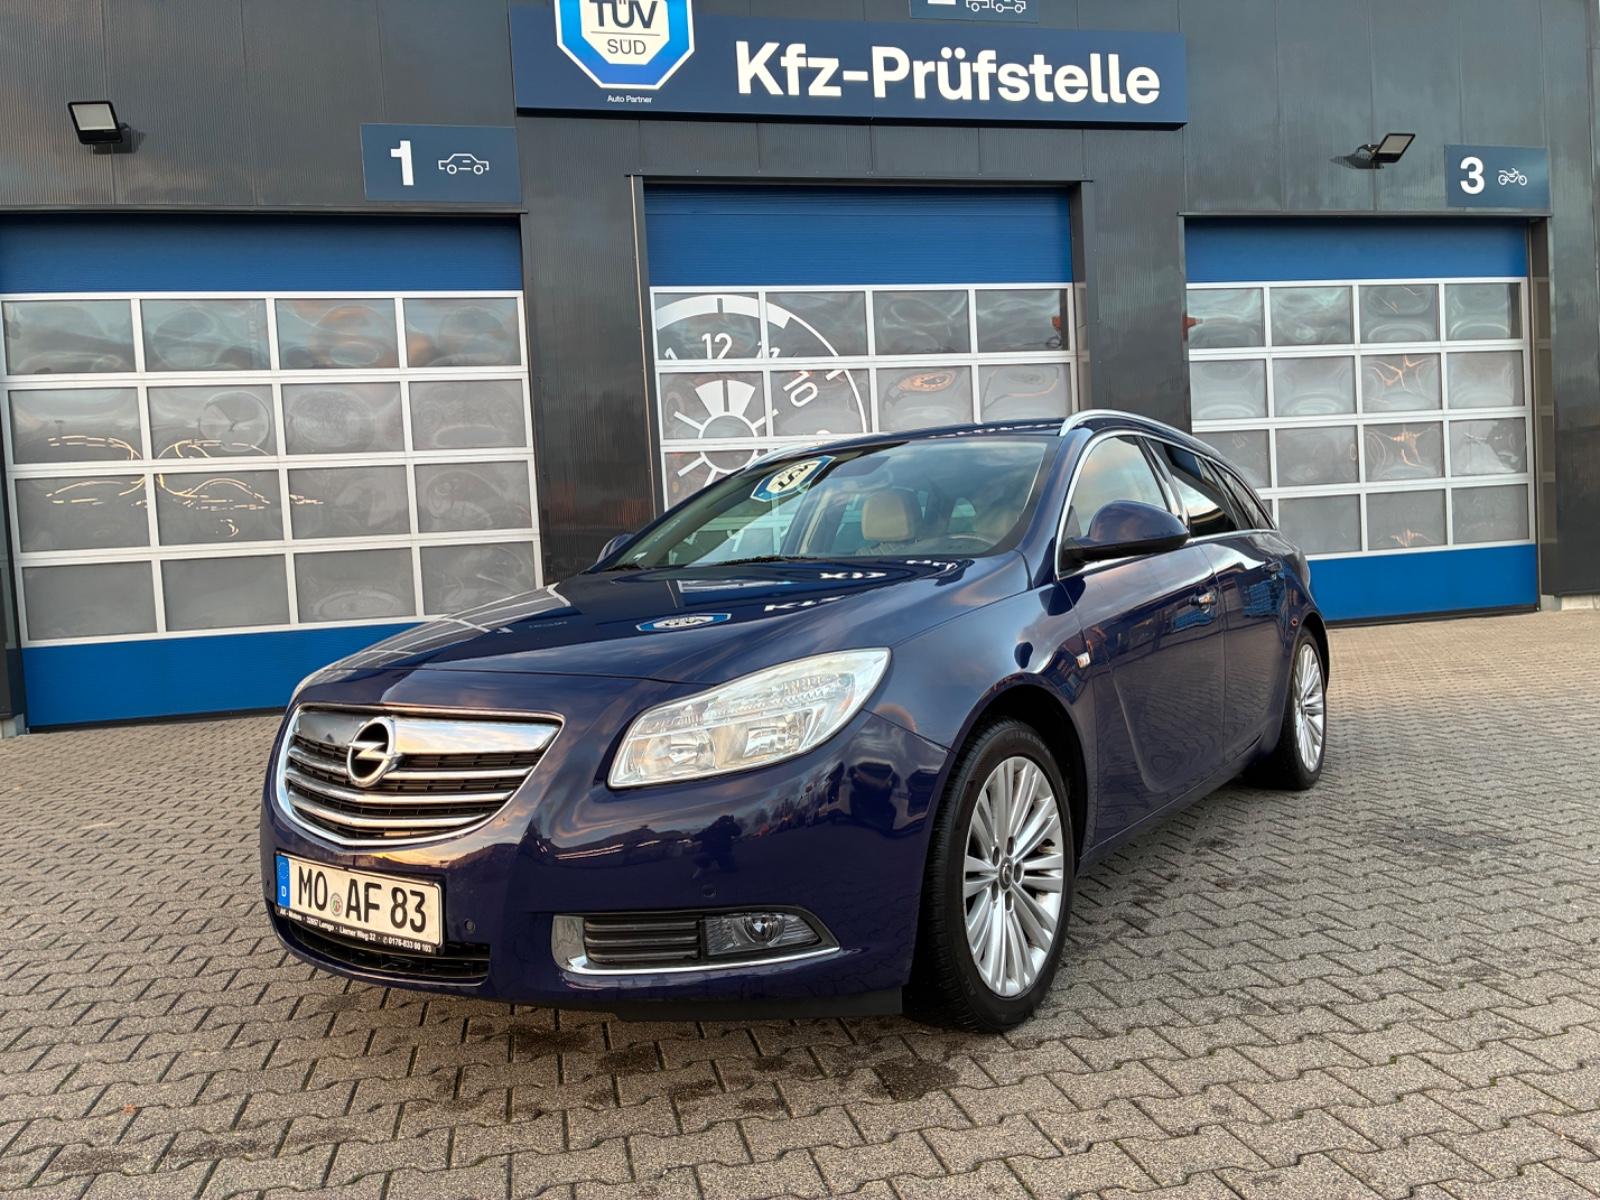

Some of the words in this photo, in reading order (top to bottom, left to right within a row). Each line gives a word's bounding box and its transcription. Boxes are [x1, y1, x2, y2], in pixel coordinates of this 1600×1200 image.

[590, 0, 658, 29] TÜV
[607, 39, 647, 55] SÜD
[735, 41, 1160, 104] Kfz-Prüfstelle
[607, 95, 625, 103] Auto
[626, 95, 652, 103] Partner
[390, 140, 414, 186] 1
[1460, 156, 1485, 194] 3
[701, 332, 733, 360] 12
[783, 370, 818, 407] 10
[281, 885, 287, 897] D
[298, 866, 328, 912] MO
[345, 878, 382, 923] AF
[390, 887, 427, 933] 83
